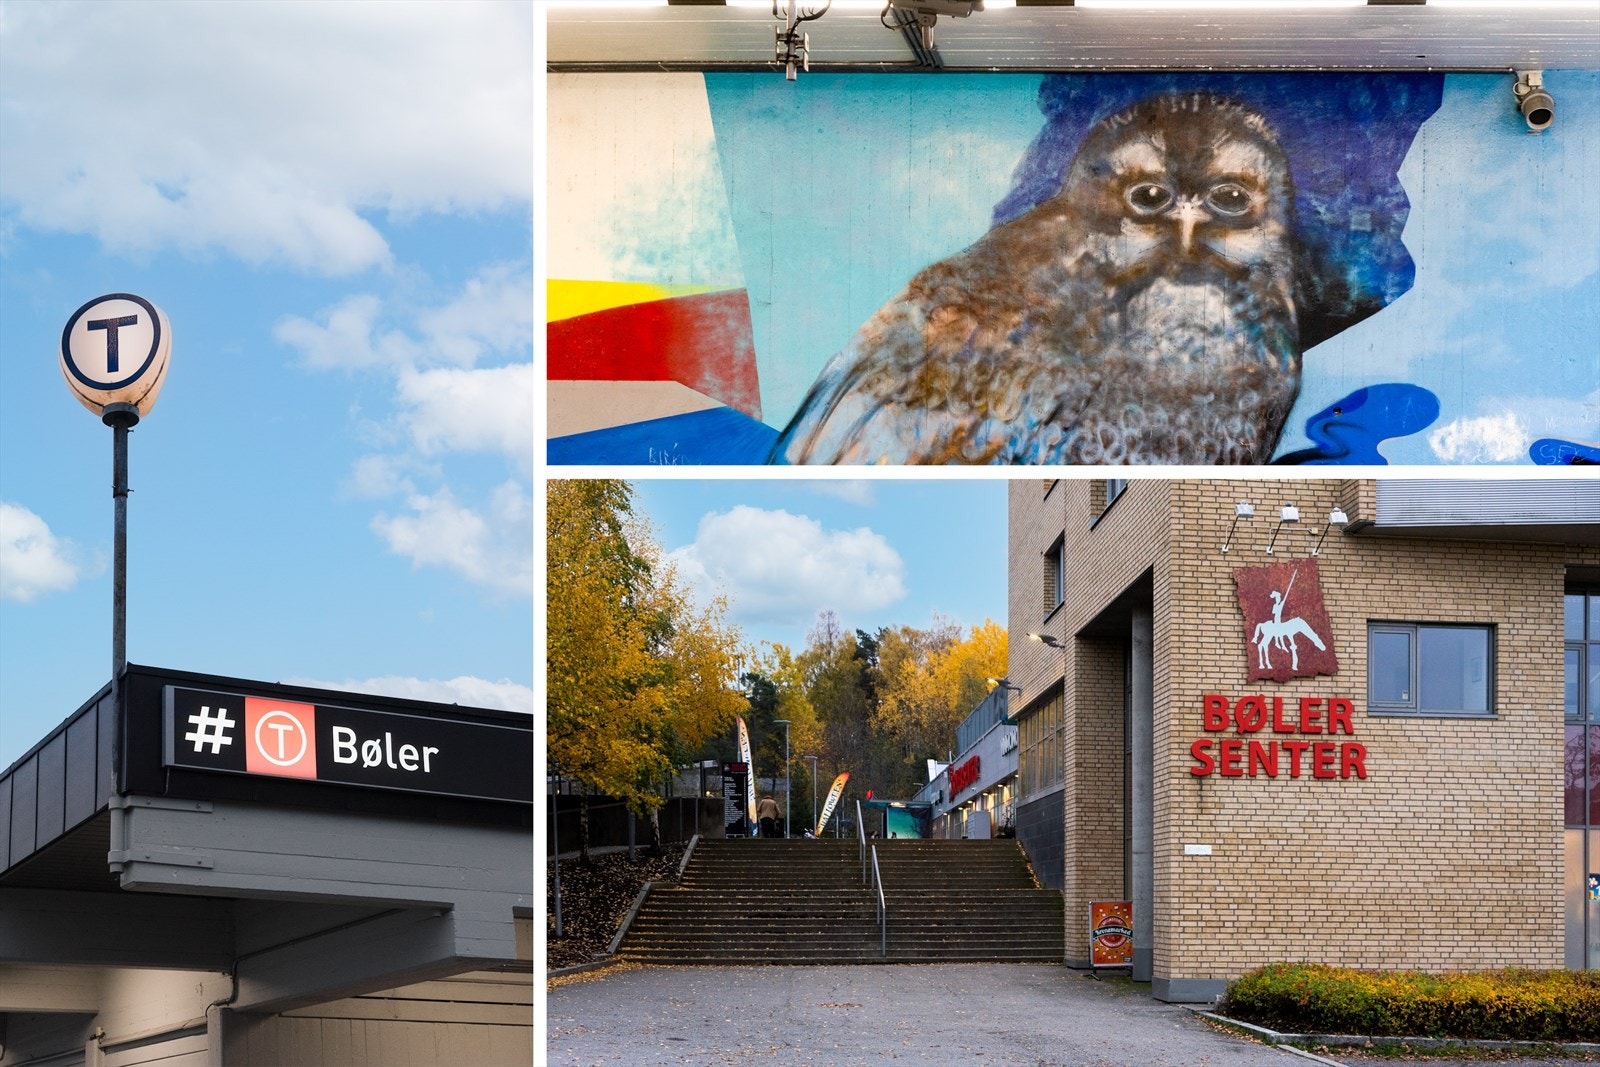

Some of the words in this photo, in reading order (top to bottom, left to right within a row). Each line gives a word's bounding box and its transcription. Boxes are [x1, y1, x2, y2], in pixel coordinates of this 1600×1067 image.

[87, 315, 138, 373] T
[1203, 694, 1354, 735] BØLER
[332, 725, 439, 773] Bøler
[1190, 739, 1368, 779] SENTER
